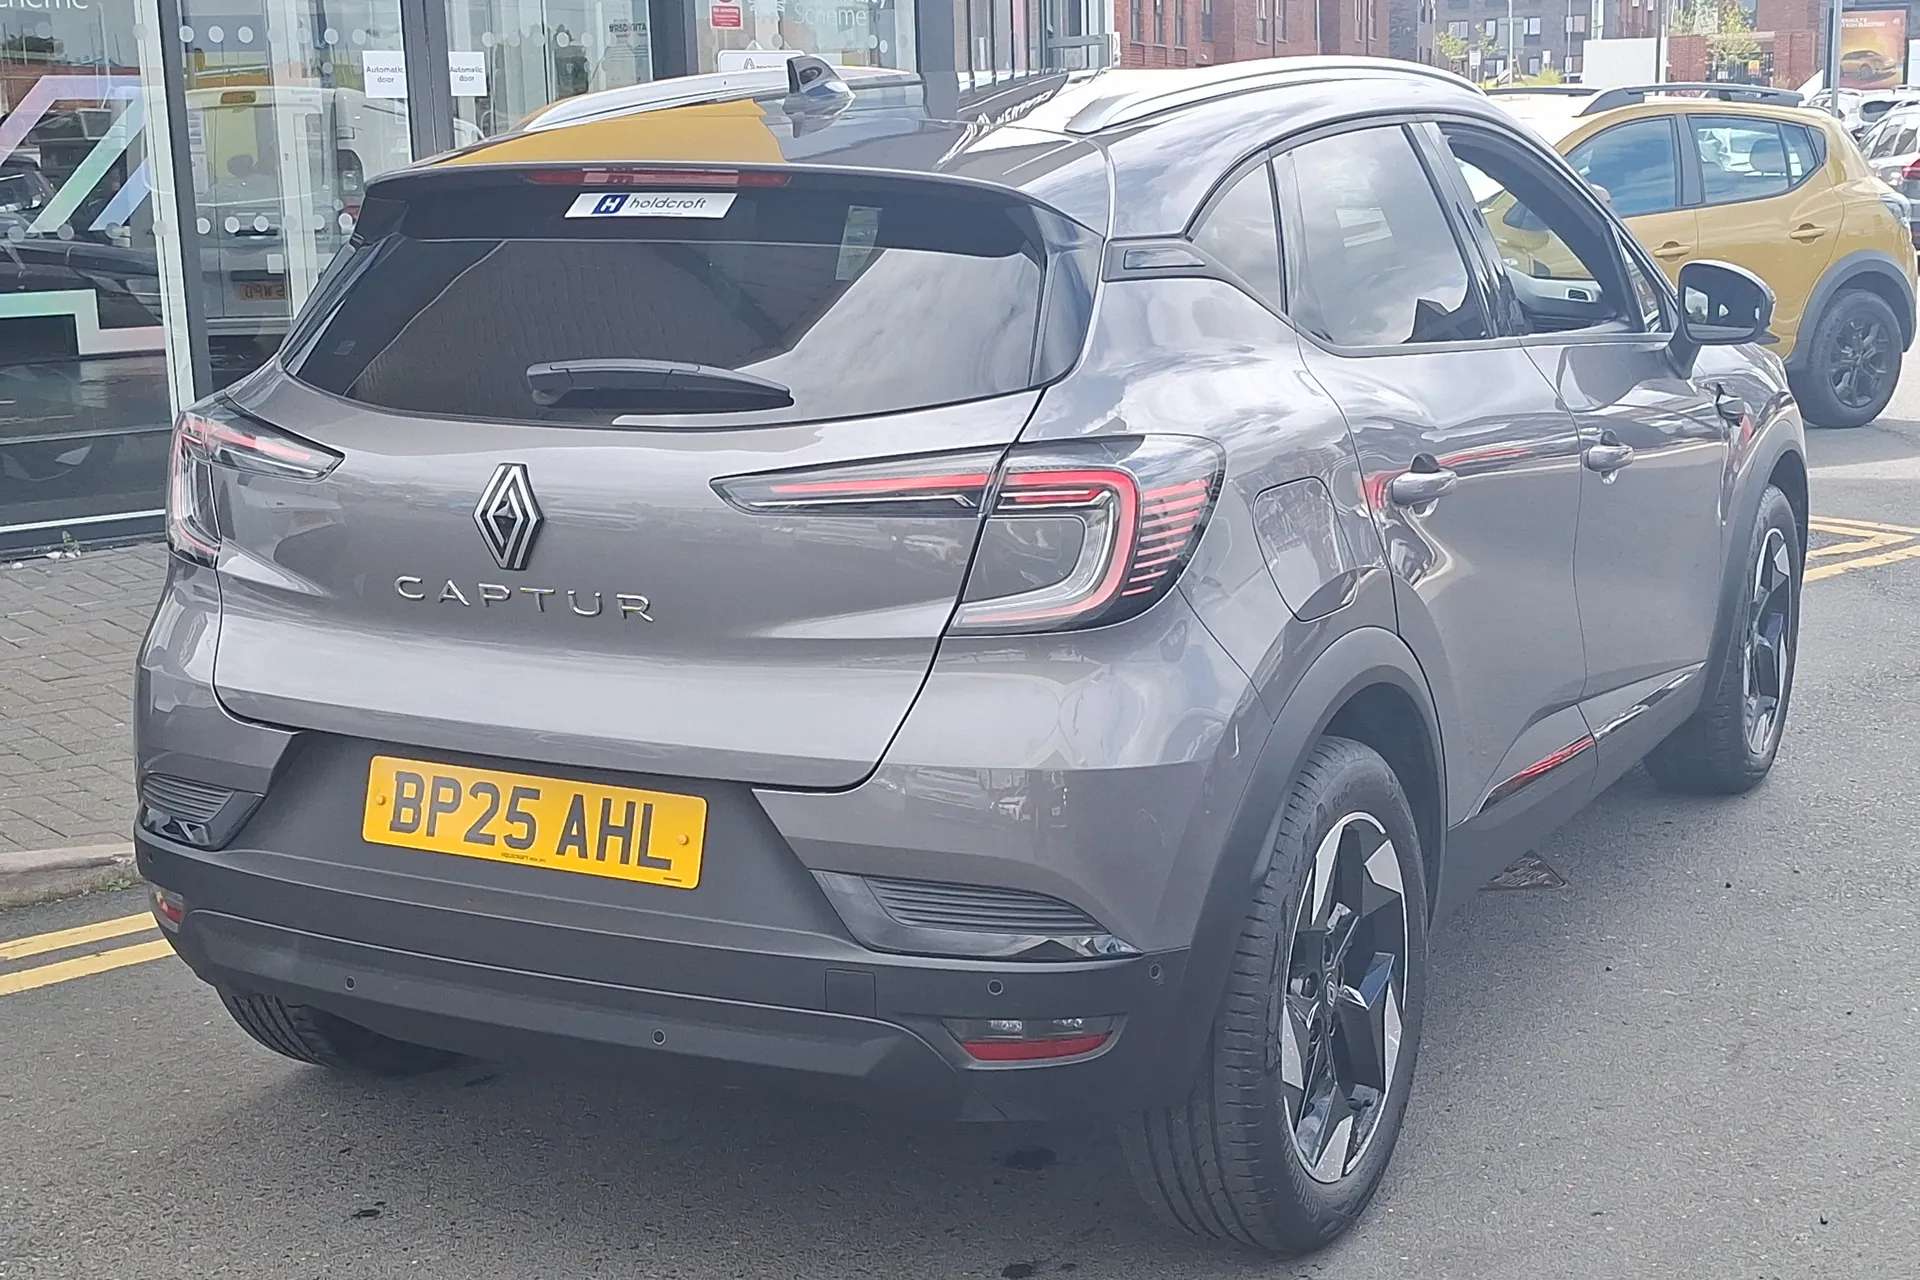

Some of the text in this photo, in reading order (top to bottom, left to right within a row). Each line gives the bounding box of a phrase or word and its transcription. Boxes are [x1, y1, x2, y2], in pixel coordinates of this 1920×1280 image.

[629, 197, 707, 209] holdcroft
[393, 575, 654, 622] CAPTUR
[389, 770, 672, 871] BP25 AHL
